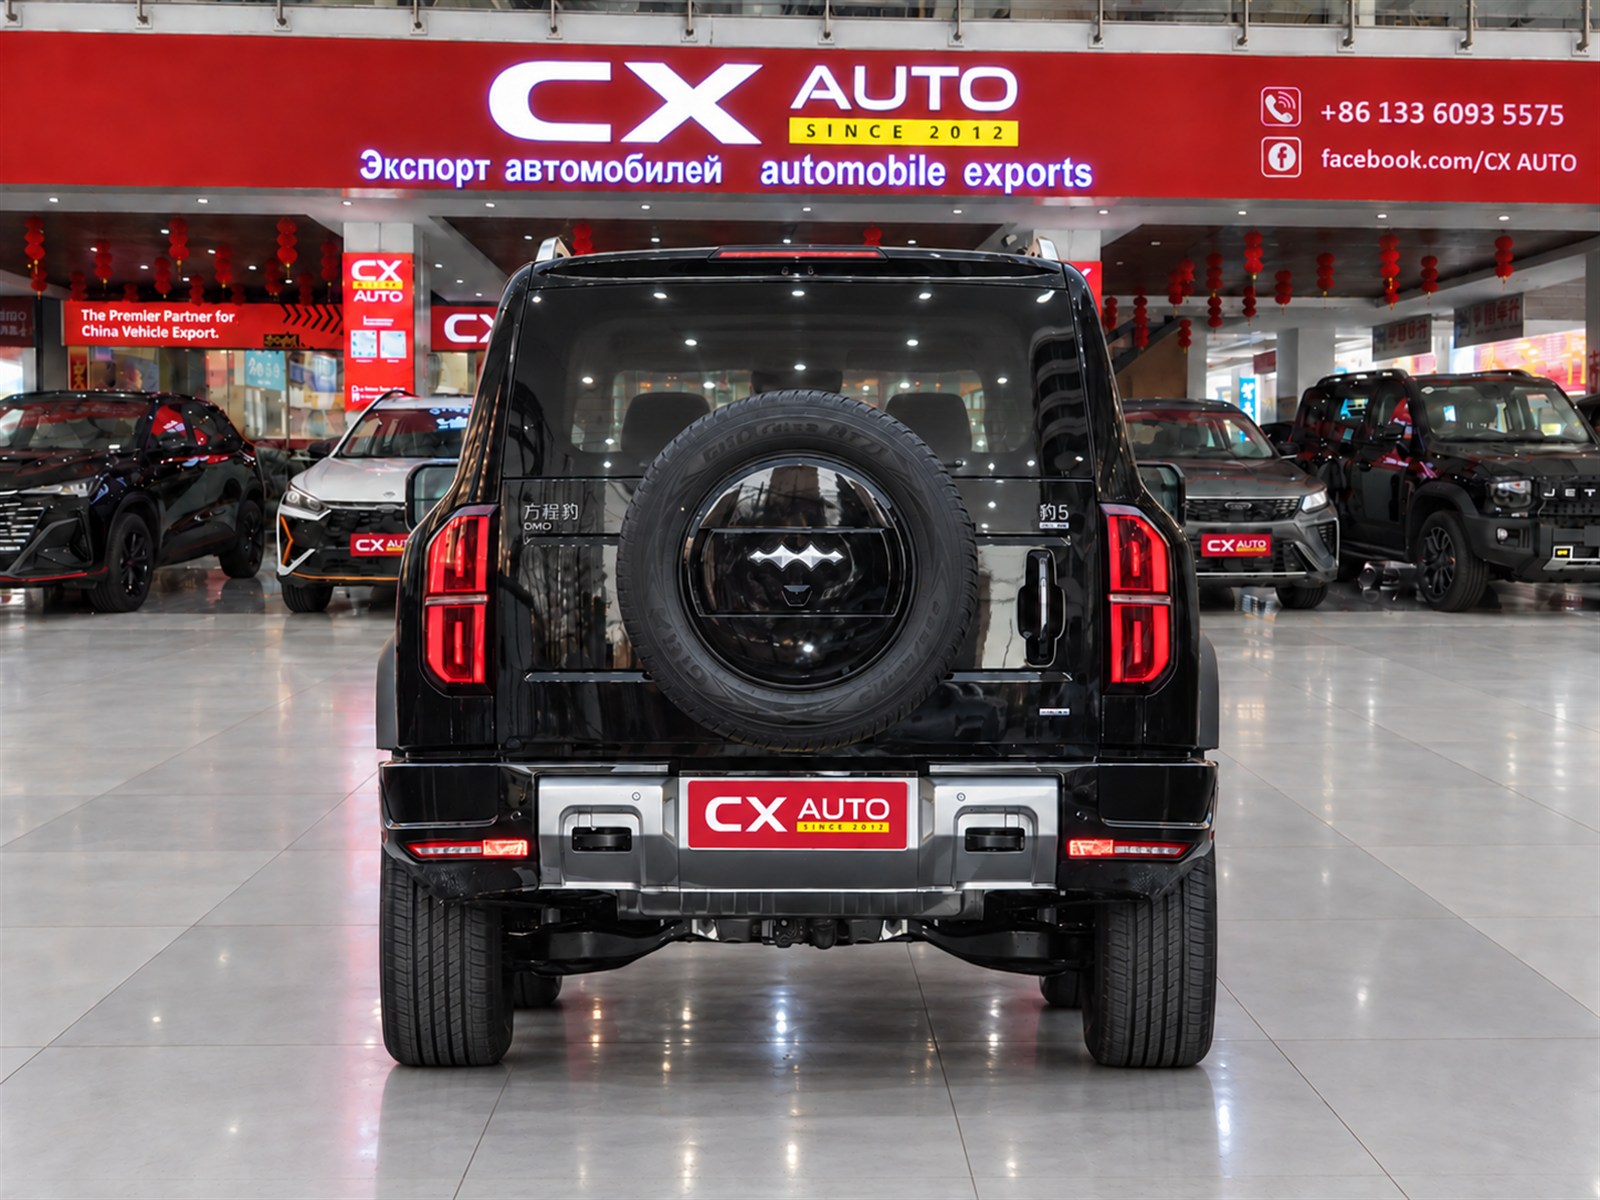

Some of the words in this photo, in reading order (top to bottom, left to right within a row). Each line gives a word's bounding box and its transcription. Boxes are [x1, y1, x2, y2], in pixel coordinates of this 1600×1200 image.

[488, 60, 763, 144] CX
[790, 65, 1018, 112] AUTO
[1321, 101, 1370, 123] +86
[1378, 102, 1424, 124] 133
[1432, 102, 1495, 125] 6093
[1502, 104, 1564, 126] 5575
[806, 123, 903, 139] SINCE
[929, 126, 1003, 140] 2012
[360, 149, 491, 188] Экспорт
[505, 153, 722, 184] автомобилей
[1321, 148, 1511, 174] facebook.com/CX
[1516, 153, 1577, 172] AUTO
[760, 154, 946, 187] automobile
[963, 157, 1093, 194] exports
[351, 259, 403, 281] CX
[353, 290, 403, 302] AUTO
[81, 309, 106, 322] The
[109, 309, 161, 322] Premier
[163, 310, 211, 323] Partner
[215, 310, 235, 323] for
[81, 325, 119, 338] China
[122, 326, 169, 338] Vehicle
[172, 326, 219, 341] Export.
[523, 503, 579, 520] 方程豹
[355, 539, 384, 552] CX
[1207, 539, 1235, 552] CX
[1237, 540, 1267, 548] AUTO
[705, 796, 787, 832] CX
[797, 797, 890, 820] AUTO
